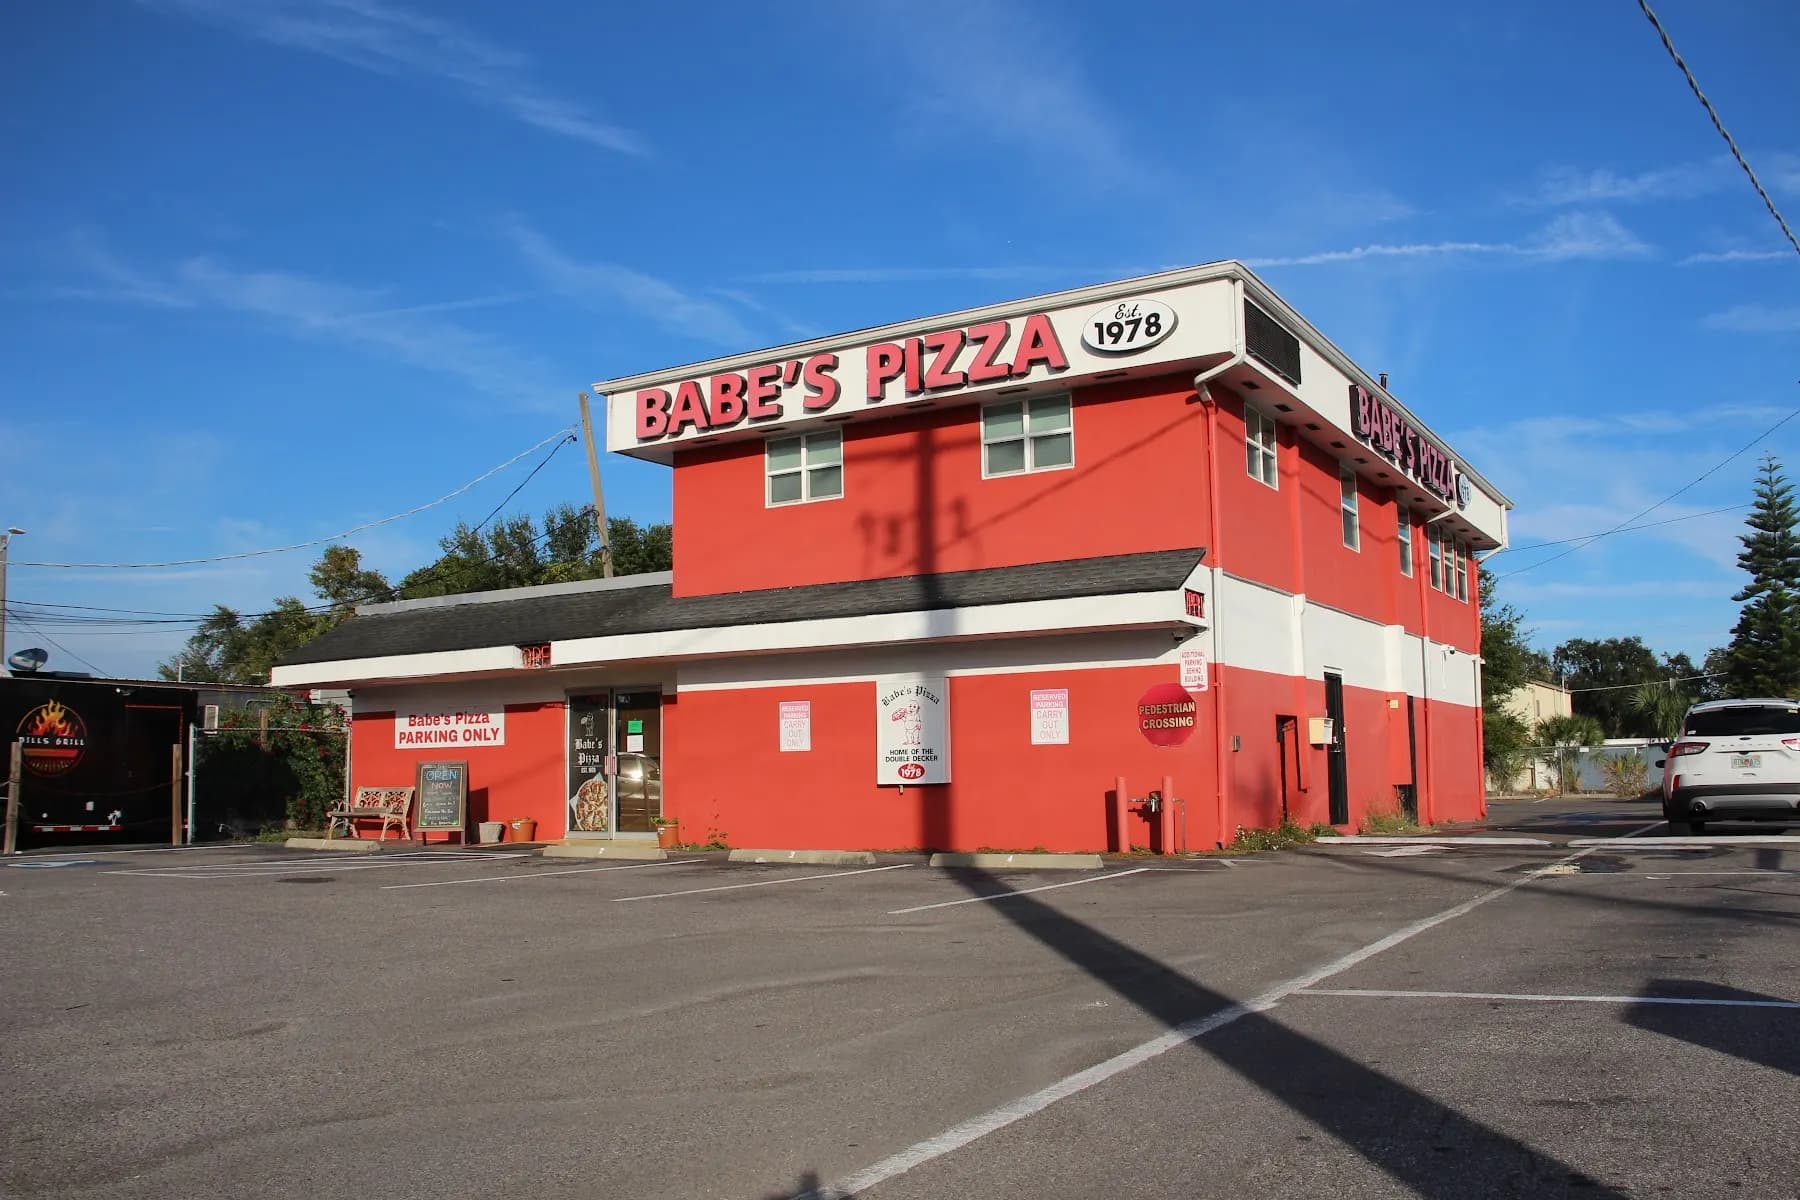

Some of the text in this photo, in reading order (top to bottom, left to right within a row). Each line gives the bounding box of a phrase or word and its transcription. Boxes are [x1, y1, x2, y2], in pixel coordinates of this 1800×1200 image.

[1114, 303, 1142, 320] Est.
[1094, 312, 1162, 345] 1978
[636, 314, 1070, 441] BABE'S PIZZA
[1356, 384, 1454, 498] BABE'S PIZZA
[881, 685, 940, 707] Babe's Pizza
[1036, 709, 1064, 719] CARRY
[1139, 702, 1196, 715] PEDESTRIAN
[408, 711, 490, 727] Babe's Pizza
[1042, 720, 1058, 729] OUT
[1142, 716, 1194, 729] CROSSING
[55, 738, 85, 746] GRILL
[399, 727, 500, 744] PARKING ONLY
[575, 737, 603, 750] Babe's
[578, 752, 600, 766] Pizza
[426, 769, 457, 781] OPEN
[901, 768, 922, 778] 1978
